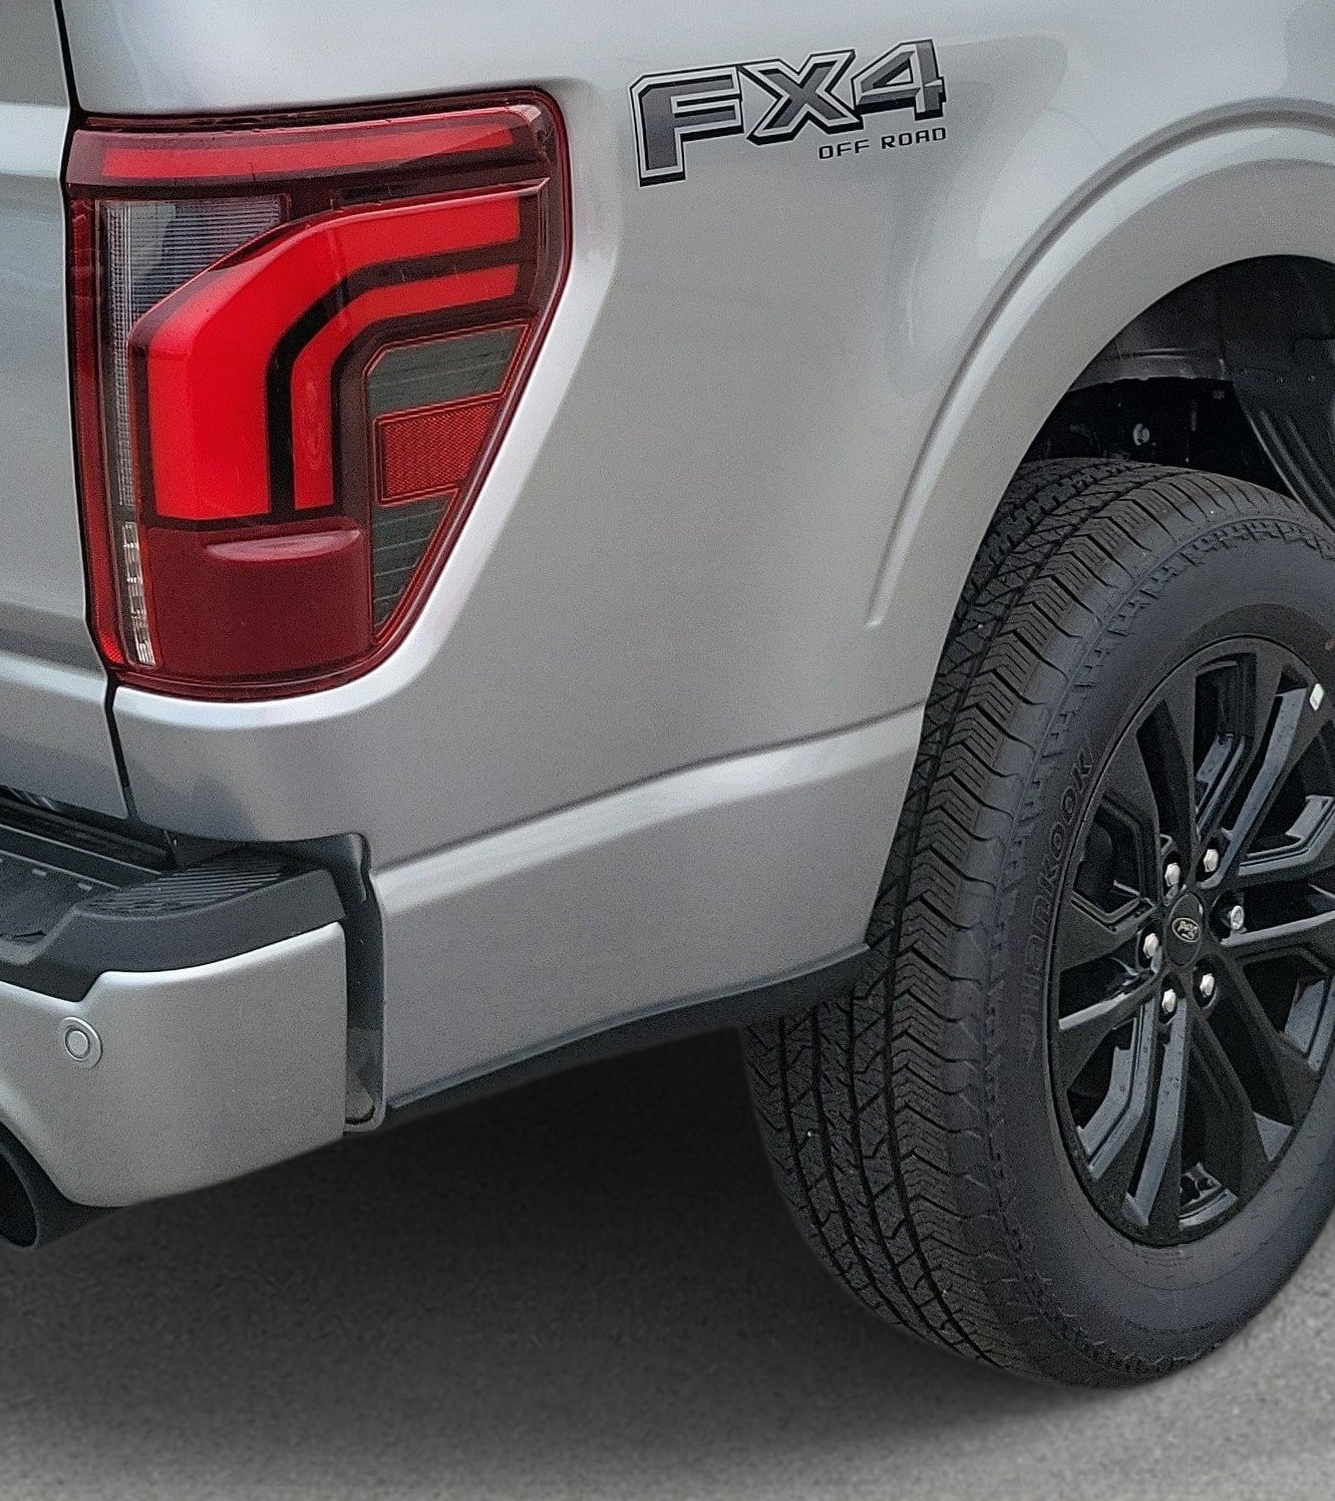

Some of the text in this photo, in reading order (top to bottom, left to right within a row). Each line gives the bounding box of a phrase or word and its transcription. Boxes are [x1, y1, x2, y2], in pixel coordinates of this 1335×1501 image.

[629, 38, 947, 187] FX4
[819, 126, 947, 160] OFF ROAD
